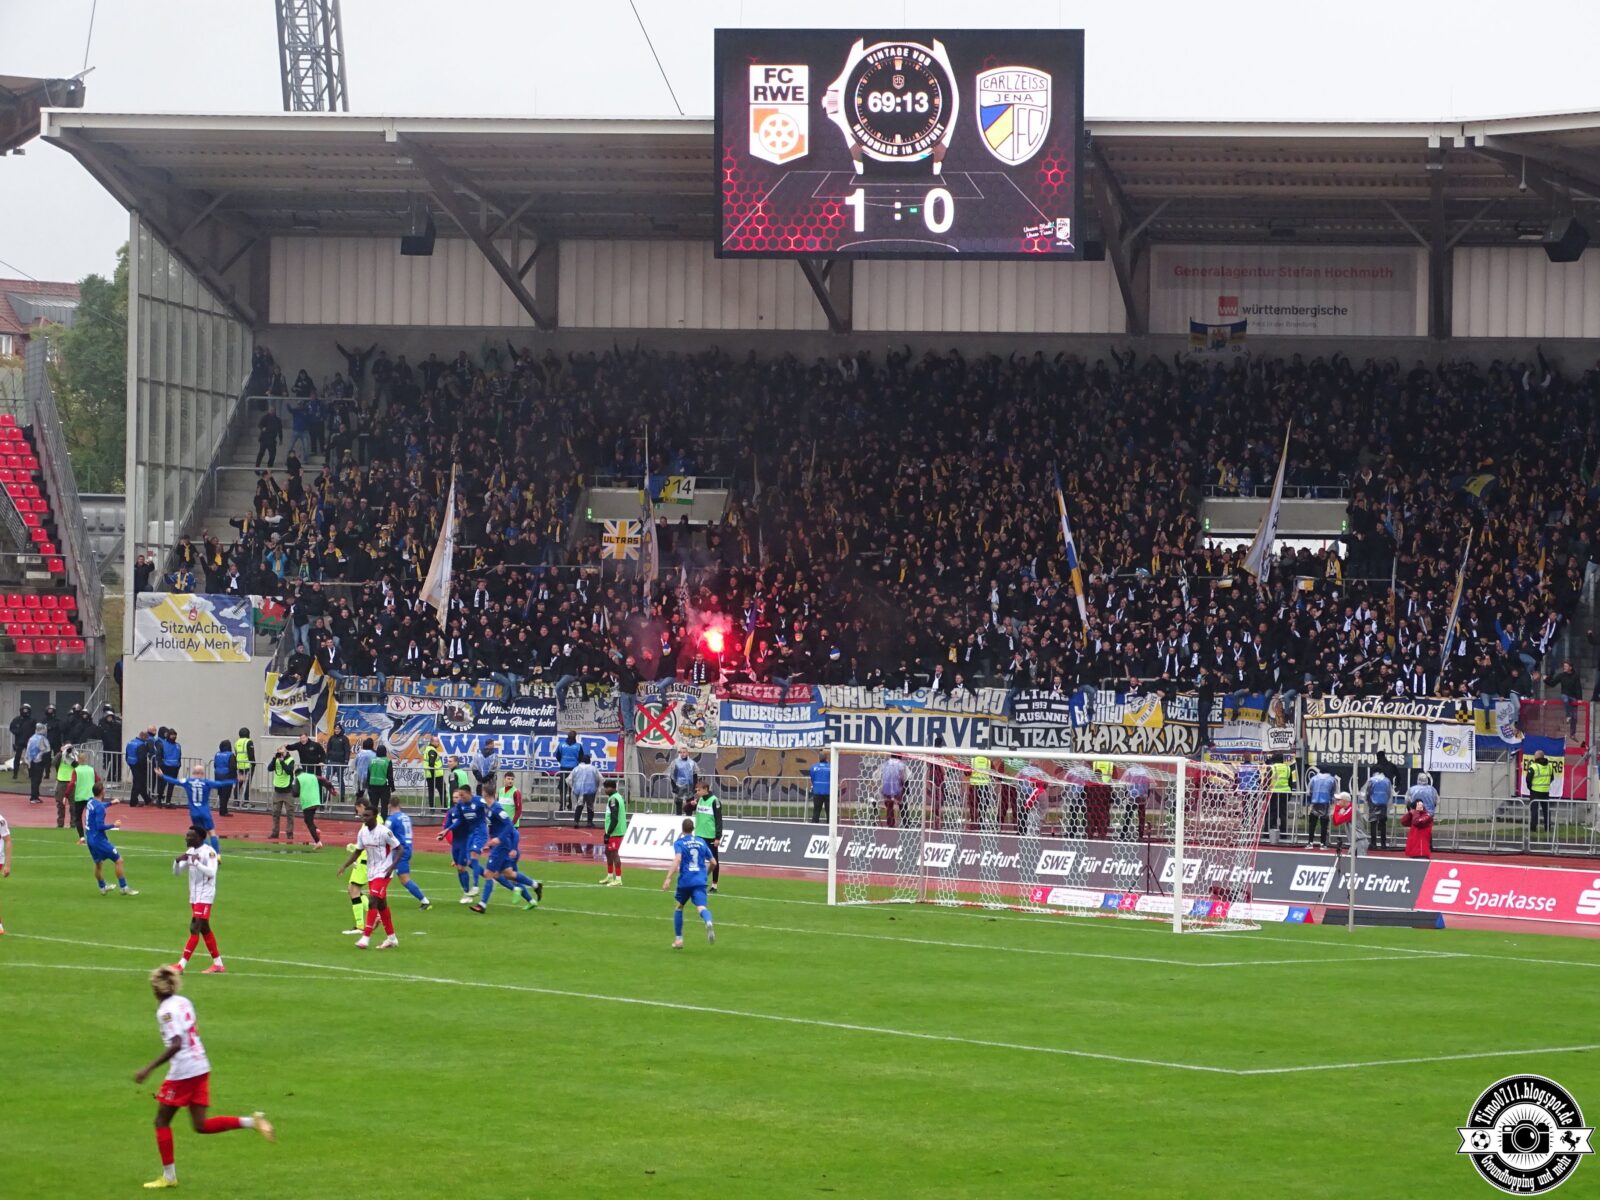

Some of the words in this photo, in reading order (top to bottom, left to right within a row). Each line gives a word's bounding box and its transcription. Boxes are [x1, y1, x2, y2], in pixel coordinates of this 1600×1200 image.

[866, 47, 910, 64] VINTAGE
[764, 67, 793, 84] FC
[983, 75, 1012, 90] CARL
[1014, 74, 1045, 90] ZEISS
[753, 86, 804, 101] RWE
[868, 91, 929, 113] 69:13
[993, 93, 1034, 103] JENA
[852, 123, 898, 155] HANDMADE
[901, 147, 914, 156] IN
[914, 122, 945, 149] ERFURT
[1016, 107, 1044, 154] FC
[845, 188, 864, 232] 1
[924, 187, 954, 234] 0
[1174, 265, 1278, 279] Generalagentur
[1279, 265, 1321, 279] Stefan
[1325, 266, 1393, 279] Hochmuth
[1242, 304, 1348, 317] württembergische
[603, 536, 639, 544] ULTRAS
[160, 621, 227, 635] SitzwAche
[155, 638, 202, 651] HolidAy
[204, 638, 230, 650] Men
[440, 682, 470, 698] MIT
[480, 701, 557, 716] Menschenrechte
[731, 704, 811, 722] UNBEUGSAM
[1015, 711, 1069, 723] LAUSANNE
[492, 716, 507, 725] dem
[510, 716, 536, 728] Abseits
[537, 718, 556, 727] holen
[825, 714, 990, 748] SÜDKURVE
[1306, 718, 1339, 728] VEGAN
[1341, 717, 1393, 730] STRAIGHT
[440, 734, 607, 759] WEIMR
[719, 730, 824, 748] UNVERKÄUFLICH
[994, 728, 1071, 748] ULTRAS
[1074, 725, 1199, 754] HARAKIRI
[1306, 729, 1422, 754] WOLFPACK
[1320, 753, 1340, 763] FCC
[734, 835, 755, 849] Für
[755, 837, 791, 853] Erfurt.
[809, 839, 830, 854] SW
[843, 841, 864, 856] Für
[864, 843, 903, 860] Erfurt.
[923, 845, 951, 862] SWE
[957, 849, 980, 865] Für
[980, 851, 1021, 868] Erfurt.
[1040, 855, 1071, 871] SWE
[1078, 856, 1101, 873] Für
[1101, 858, 1143, 876] Erfurt.
[1205, 864, 1230, 881] Für
[1229, 866, 1273, 885] Erfurt.
[1296, 869, 1328, 887] SWE
[1364, 874, 1411, 894] Erfurt.
[1465, 887, 1557, 911] Sparkasse
